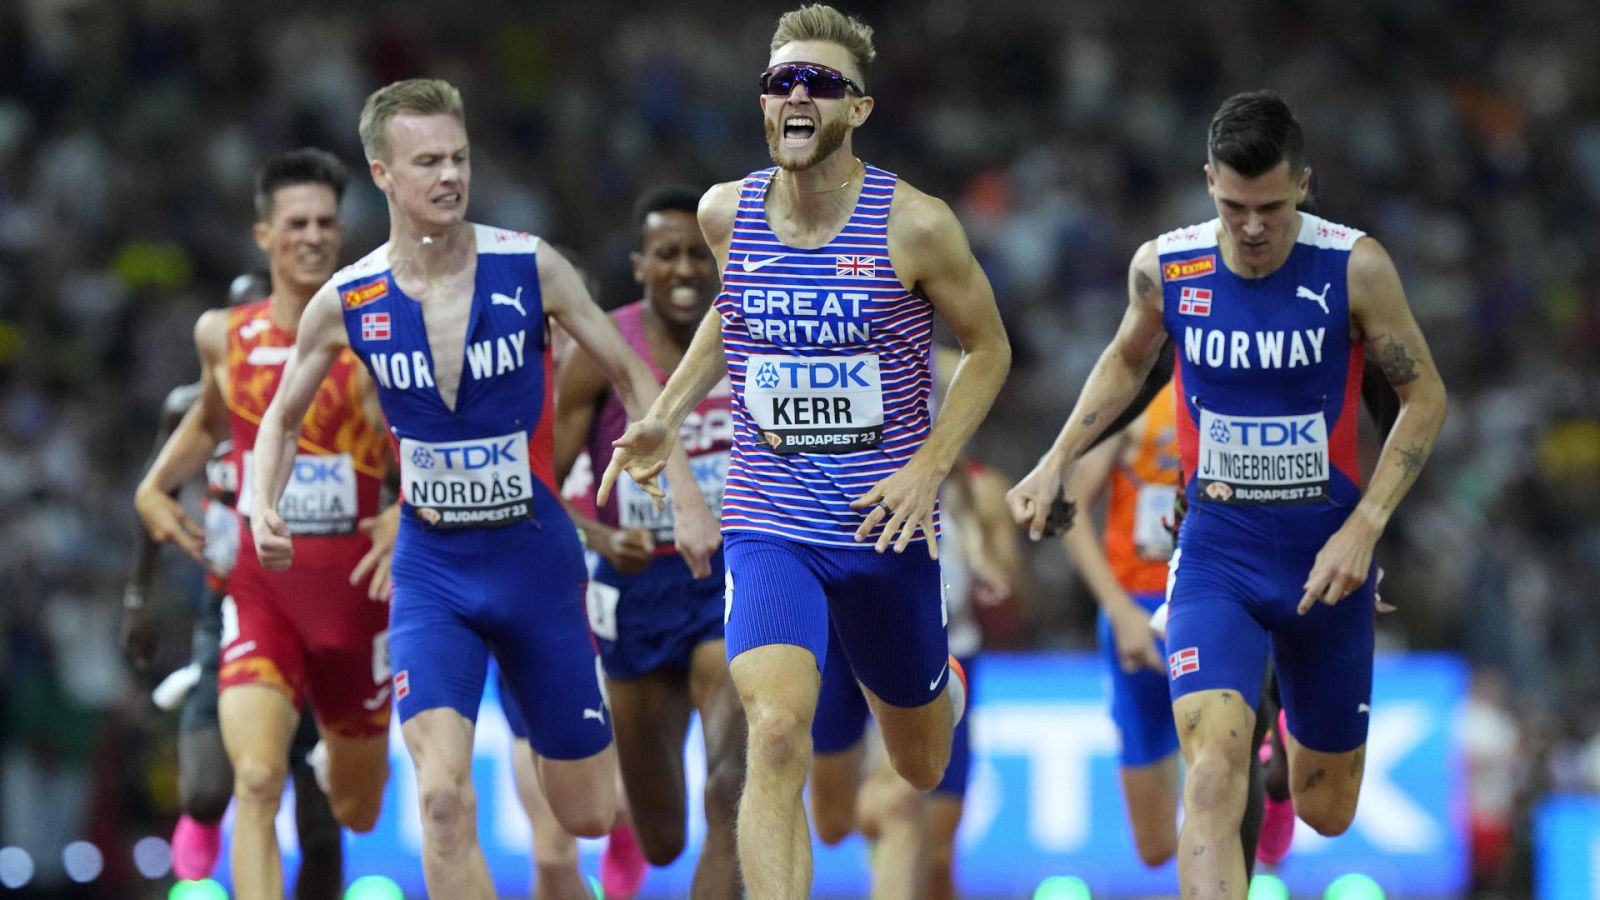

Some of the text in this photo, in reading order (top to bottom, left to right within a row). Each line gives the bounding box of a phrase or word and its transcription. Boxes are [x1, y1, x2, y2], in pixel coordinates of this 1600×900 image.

[742, 289, 869, 318] GREAT
[744, 318, 870, 344] BRITAIN
[1184, 326, 1326, 369] NORWAY
[779, 360, 871, 389] TDK
[772, 397, 853, 426] KERR
[786, 431, 876, 447] BUDAPEST 23
[1230, 418, 1318, 447] TDK
[433, 438, 517, 470] TDK
[1203, 449, 1323, 481] J. INGEBRIGTSEN
[294, 460, 343, 483] DK
[411, 471, 522, 504] NORDÅS
[1235, 486, 1322, 501] BUDAPEST 23
[443, 503, 528, 522] BUDAPEST 23
